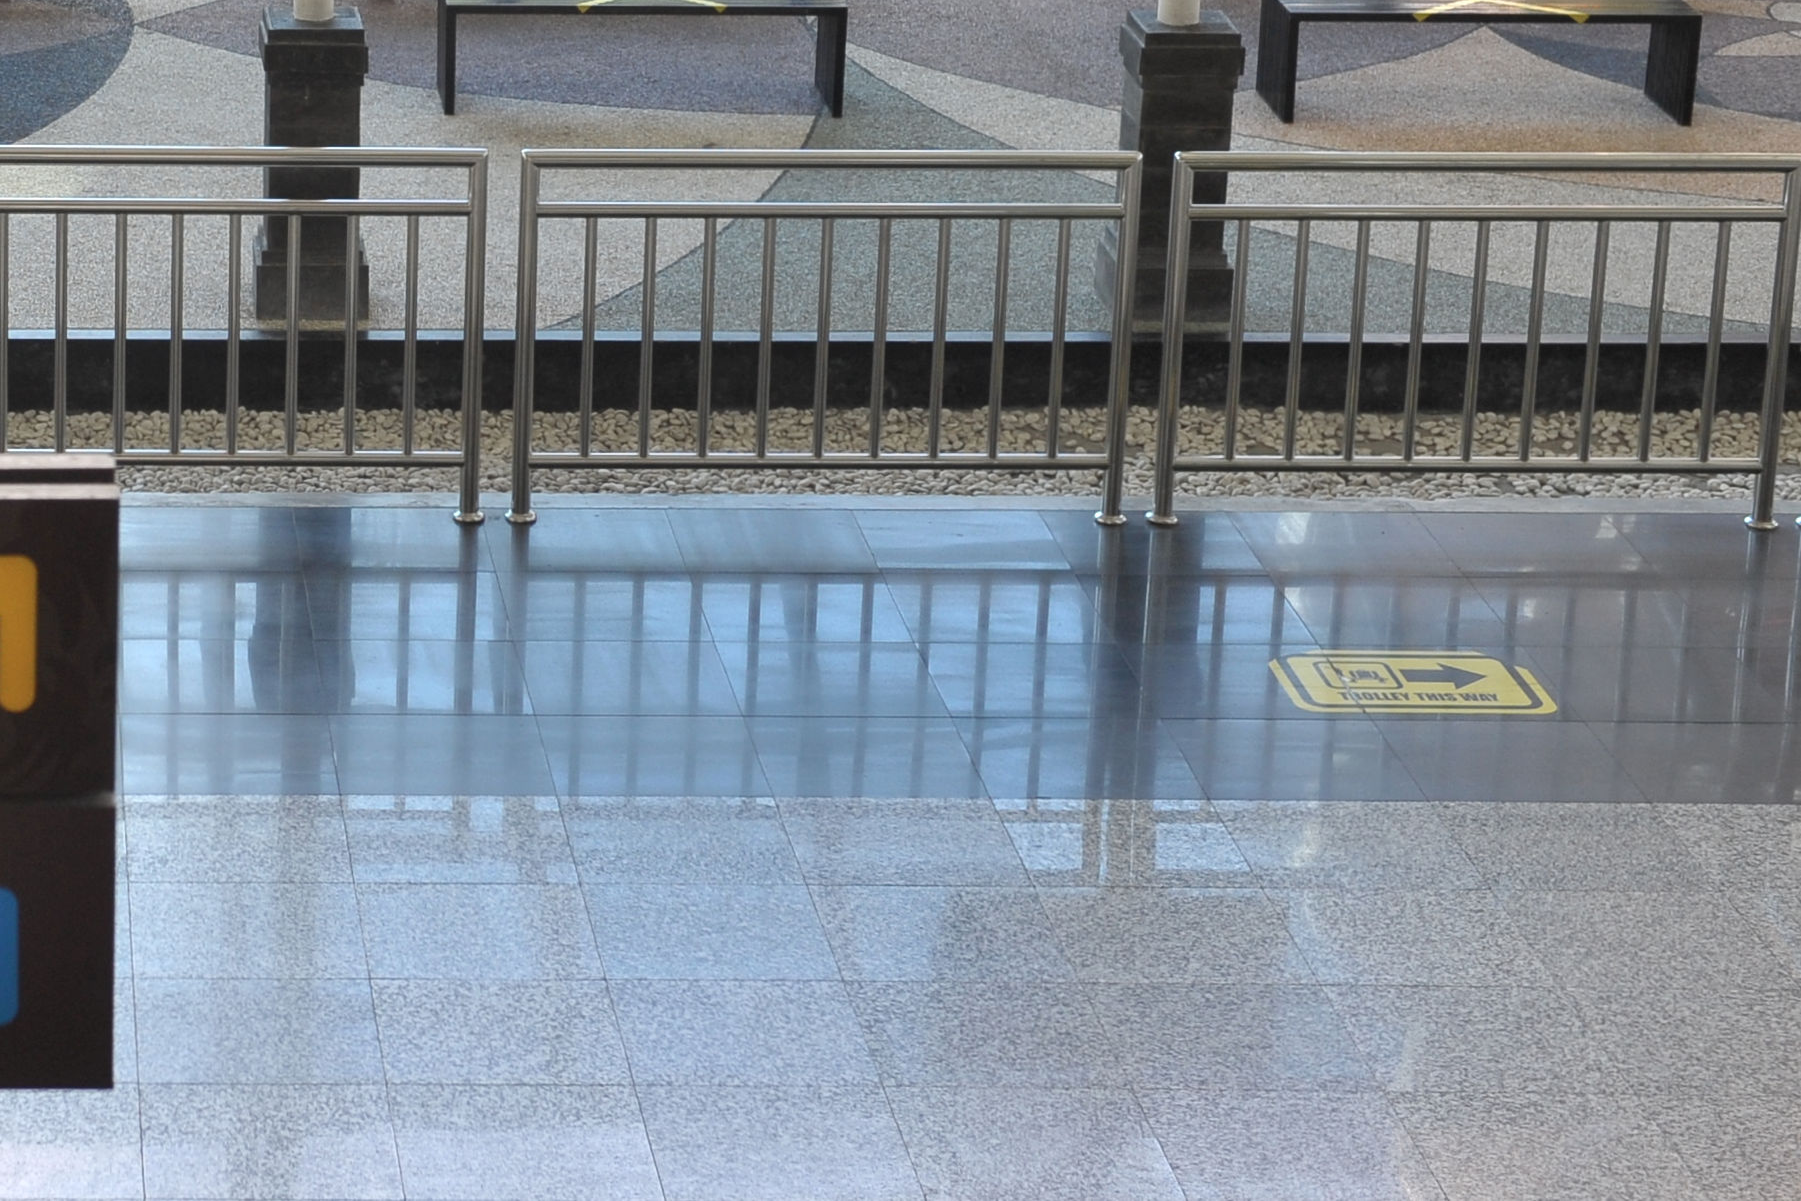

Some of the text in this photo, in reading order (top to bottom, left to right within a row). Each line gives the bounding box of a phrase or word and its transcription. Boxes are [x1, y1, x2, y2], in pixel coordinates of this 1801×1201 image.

[1336, 691, 1499, 703] TROLLEY THIS WAY
